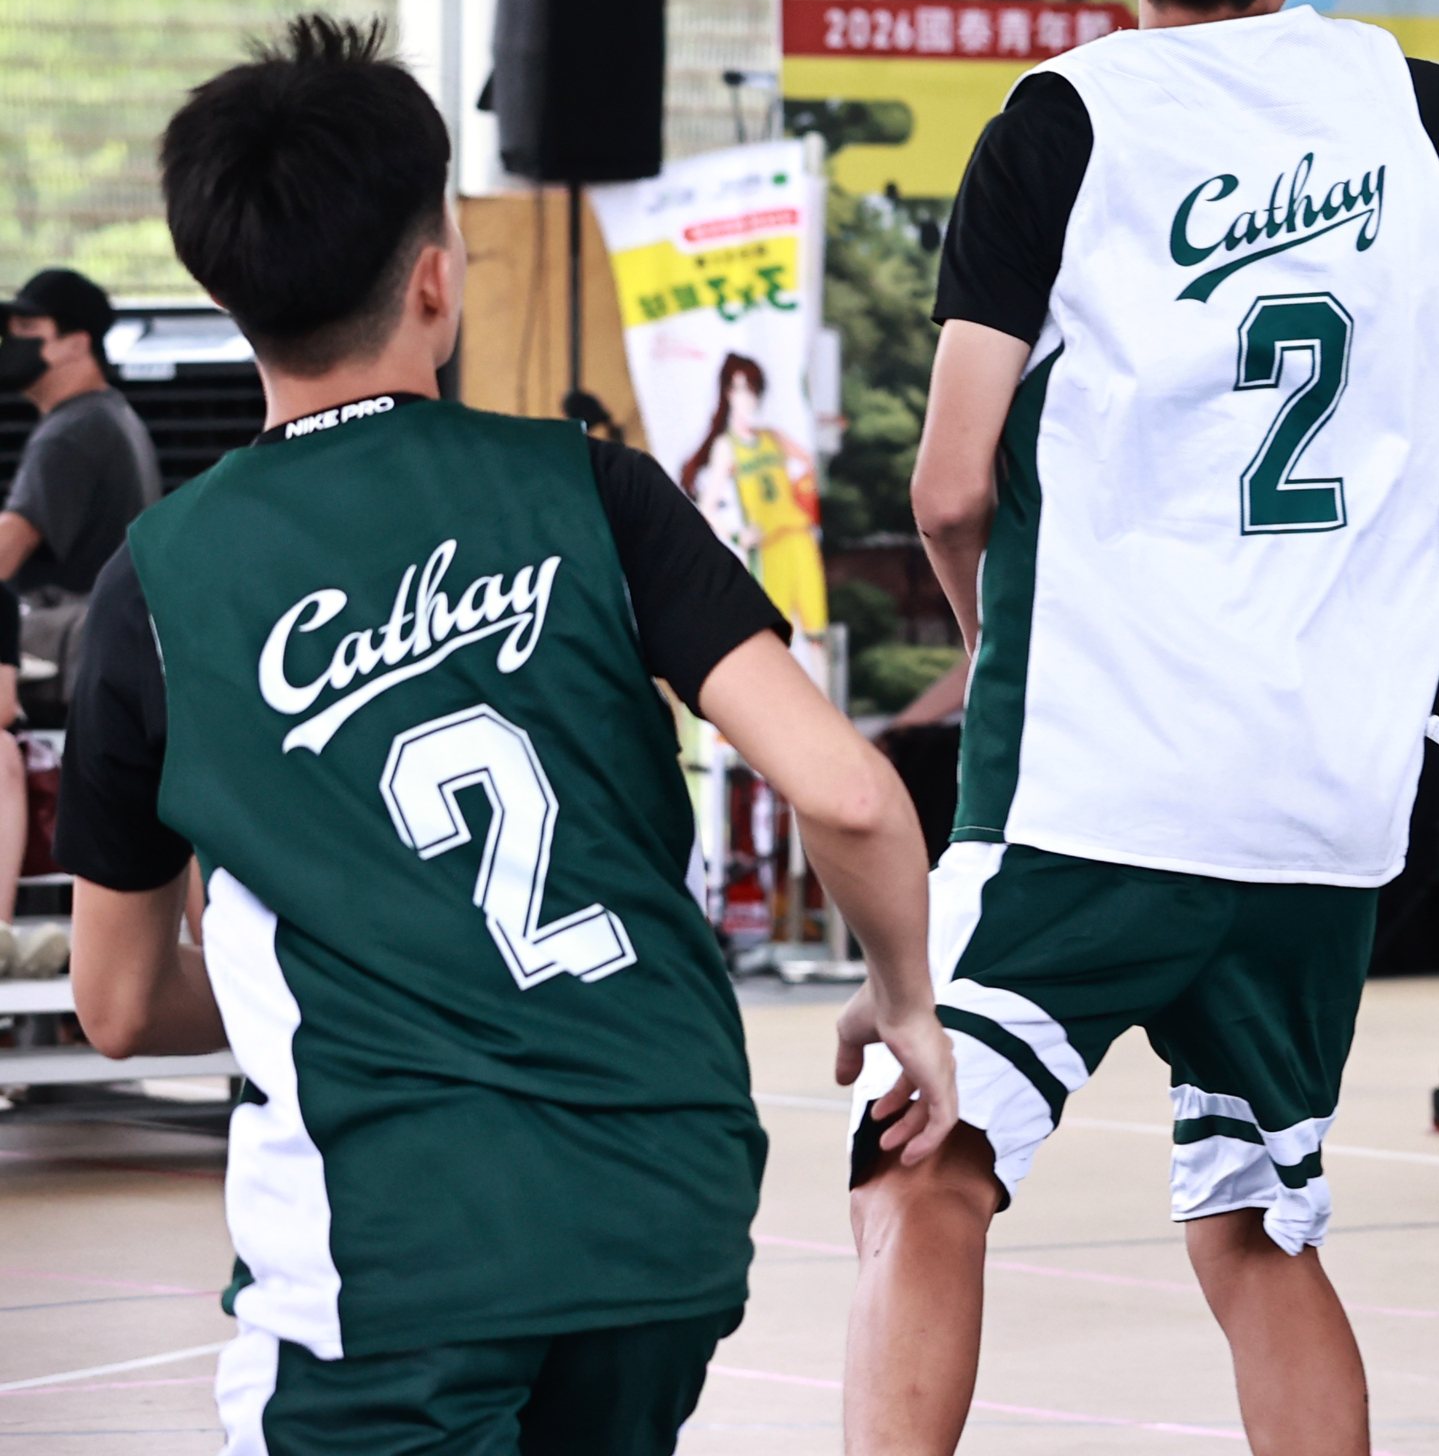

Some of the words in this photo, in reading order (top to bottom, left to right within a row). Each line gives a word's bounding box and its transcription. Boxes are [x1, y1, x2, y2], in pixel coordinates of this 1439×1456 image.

[1170, 152, 1386, 303] Cathay
[285, 409, 340, 440] NIKE
[340, 396, 395, 424] PRO
[1233, 291, 1355, 536] 2
[259, 539, 562, 755] Cathay
[379, 703, 638, 991] 2
